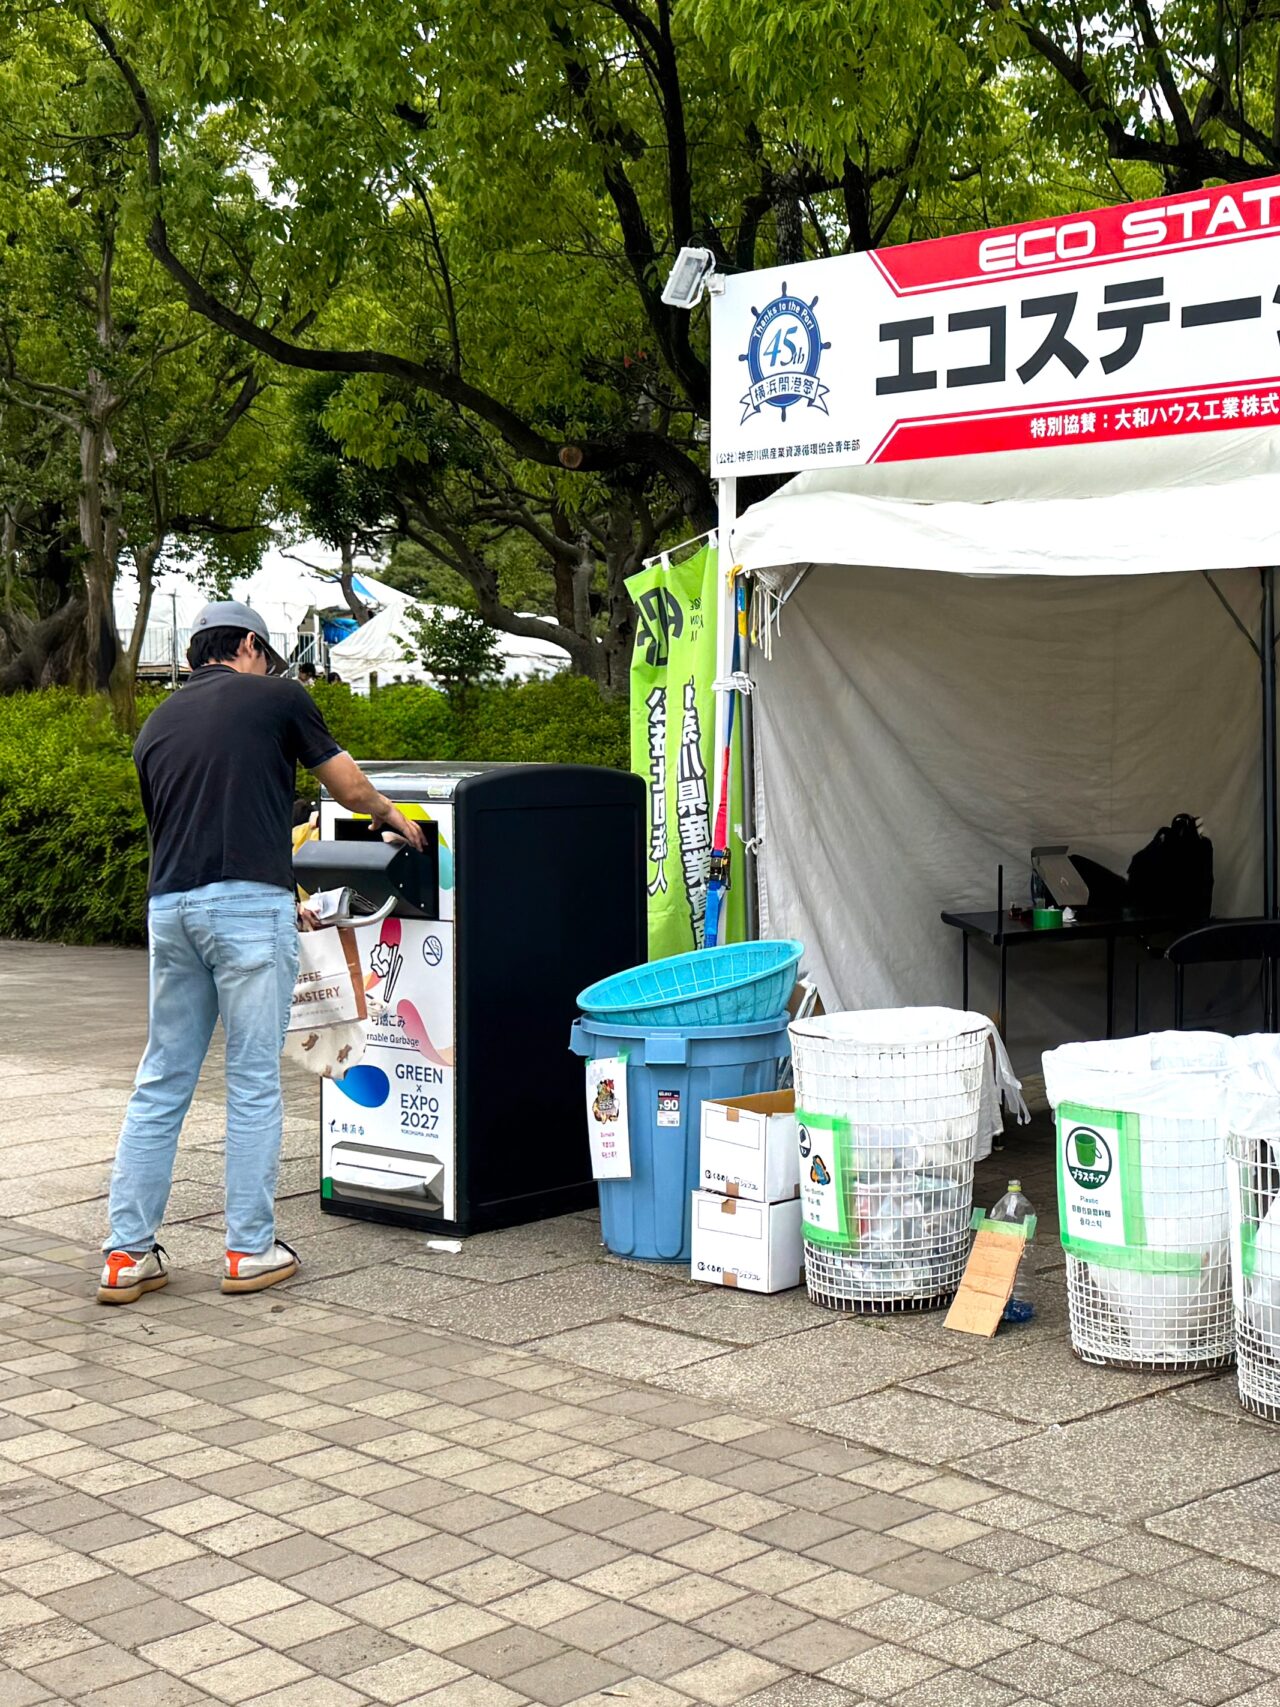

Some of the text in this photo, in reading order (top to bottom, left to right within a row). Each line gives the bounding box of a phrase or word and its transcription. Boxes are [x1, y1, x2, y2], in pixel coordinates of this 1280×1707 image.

[978, 221, 1096, 273] ECO
[753, 305, 777, 339] Thanks
[763, 325, 805, 367] 45th
[754, 376, 815, 401] 横浜開港祭
[389, 1034, 420, 1048] Garbage
[395, 1064, 443, 1085] GREEN
[400, 1094, 439, 1113] EXPO
[400, 1111, 439, 1131] 2027
[1072, 1169, 1105, 1183] プラスチック
